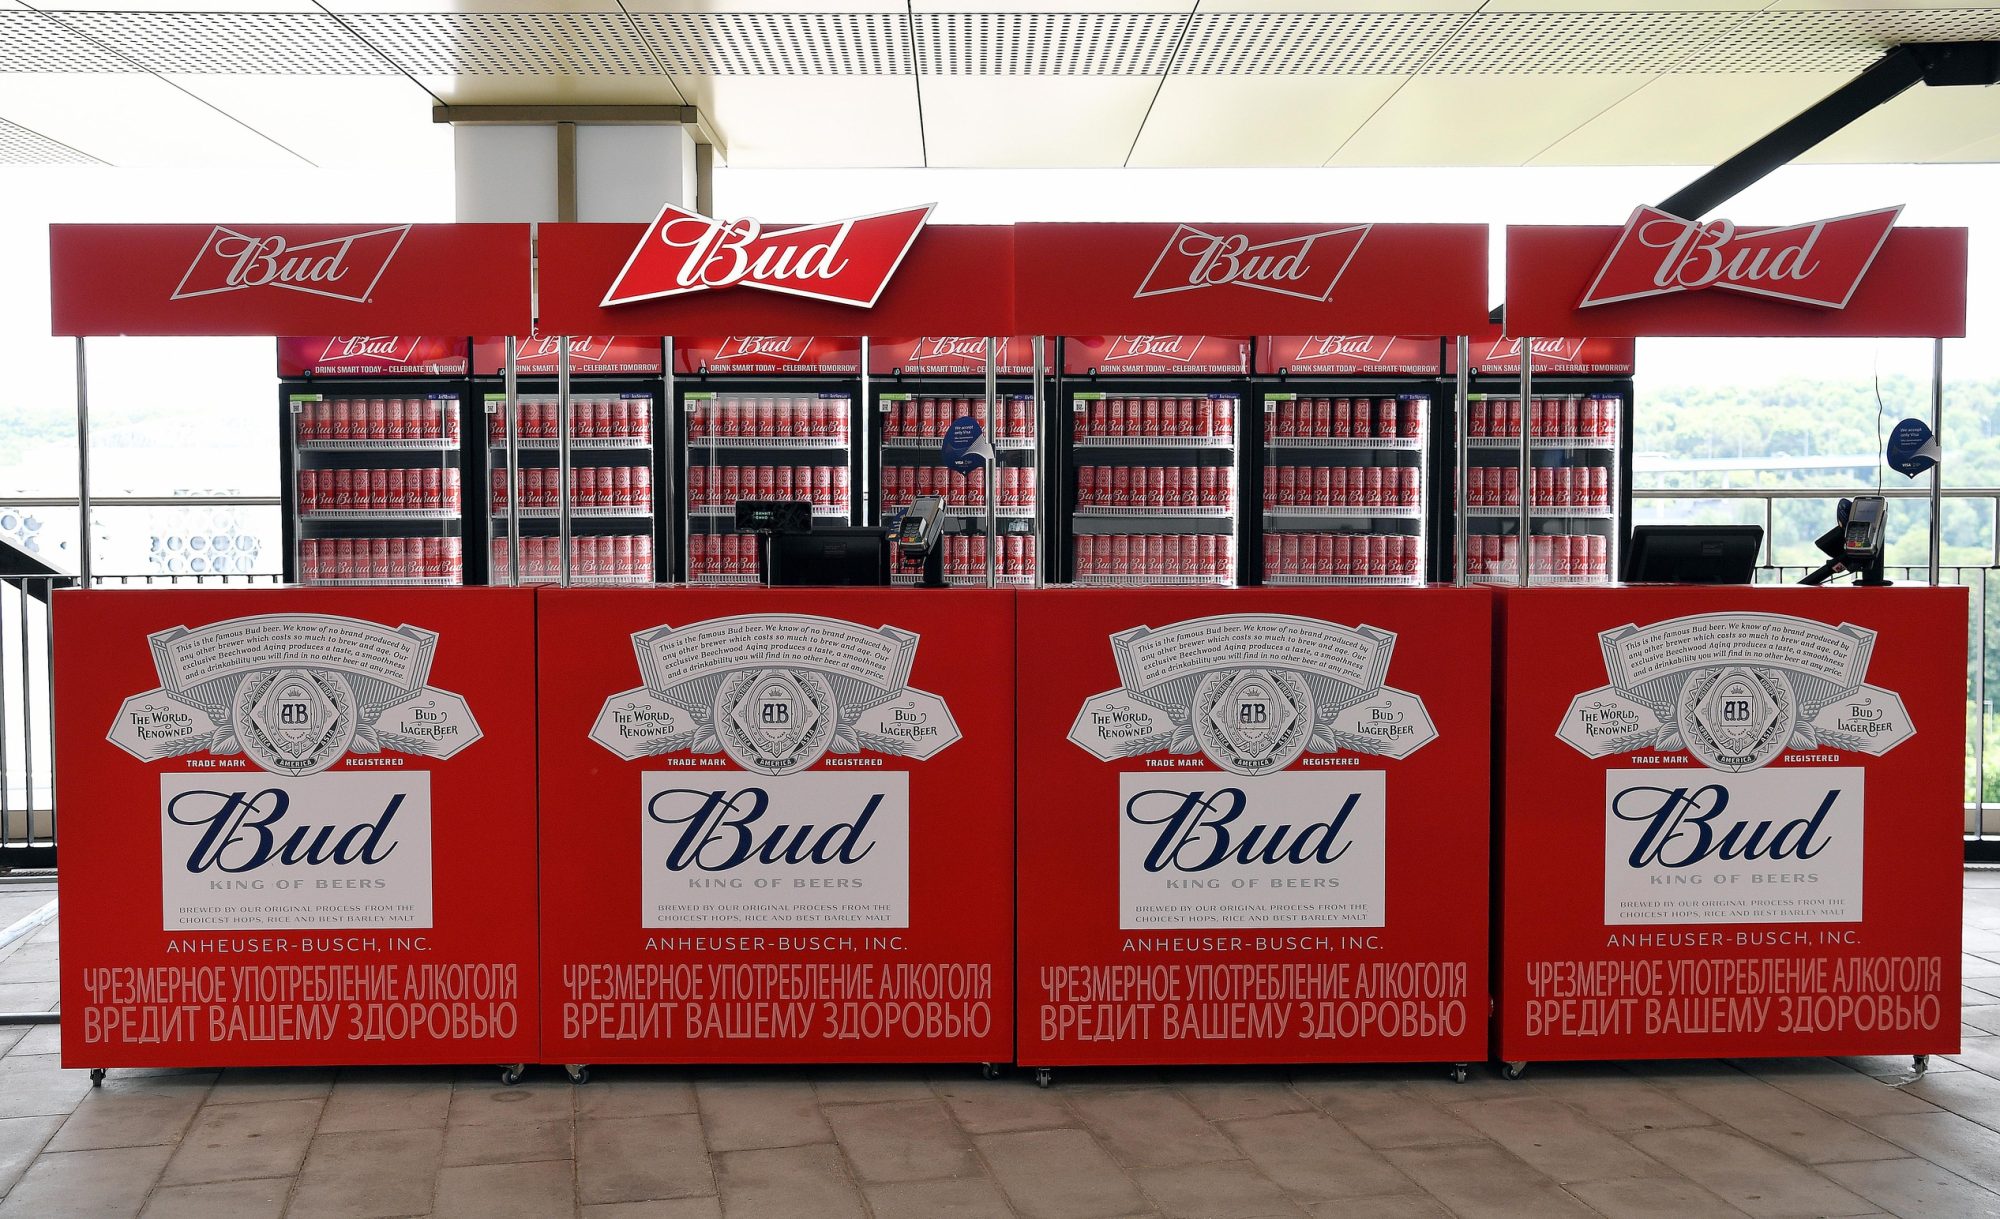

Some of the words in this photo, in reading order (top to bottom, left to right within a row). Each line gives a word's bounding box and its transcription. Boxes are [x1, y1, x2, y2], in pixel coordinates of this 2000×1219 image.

[661, 218, 856, 286] Bud
[1178, 234, 1316, 284] Bud
[1638, 219, 1826, 286] Bud
[215, 236, 354, 286] Bud
[338, 336, 398, 355] Bud
[734, 336, 792, 354] Bud
[928, 336, 987, 354] Bud
[1124, 336, 1183, 354] Bud
[1315, 336, 1373, 354] Bud
[710, 364, 730, 372] DRINK
[732, 364, 754, 372] SMART
[755, 364, 775, 372] TODAY
[782, 364, 818, 372] CELEBRATE
[818, 364, 856, 372] TOMORROW
[176, 643, 192, 653] This
[202, 636, 213, 645] the
[215, 631, 243, 643] famous
[245, 626, 260, 634] Bud
[318, 625, 328, 633] of
[340, 628, 363, 639] brand
[365, 634, 400, 648] produced
[401, 642, 410, 653] by
[130, 713, 150, 724] THE
[152, 712, 192, 726] WORLD
[282, 704, 308, 724] AB
[415, 709, 437, 720] BUD
[613, 712, 632, 723] THE
[634, 711, 674, 725] WORLD
[763, 703, 789, 724] AB
[895, 710, 917, 721] BUD
[1091, 713, 1110, 724] THE
[1112, 711, 1152, 726] WORLD
[1240, 703, 1267, 724] AB
[1372, 709, 1393, 720] BUD
[1579, 710, 1598, 721] THE
[1600, 709, 1639, 723] WORLD
[1724, 701, 1750, 721] AB
[1852, 706, 1873, 717] BUD
[138, 726, 192, 740] RENOWNED
[400, 722, 433, 737] LAGER
[434, 725, 458, 735] BEER
[620, 725, 674, 738] RENOWNED
[880, 722, 912, 738] LAGER
[913, 726, 937, 736] BEER
[1098, 726, 1152, 739] RENOWNED
[1357, 721, 1389, 737] LAGER
[1390, 725, 1414, 735] BEER
[1586, 723, 1639, 737] RENOWNED
[1837, 718, 1868, 734] LAGER
[1869, 722, 1892, 732] BEER
[321, 730, 335, 746] ASIA
[346, 758, 404, 766] REGISTERED
[1146, 759, 1174, 767] TRADE
[167, 788, 406, 873] Bud
[648, 787, 884, 872] Bud
[1126, 788, 1361, 872] Bud
[1611, 784, 1840, 868] Bud
[210, 880, 264, 890] KING
[275, 879, 304, 890] OF
[316, 879, 386, 889] BEERS
[689, 878, 743, 888] KING
[754, 878, 782, 888] OF
[794, 878, 864, 888] BEERS
[1167, 879, 1220, 889] KING
[1231, 879, 1259, 889] OF
[1271, 878, 1340, 888] BEERS
[1651, 874, 1703, 884] KING
[1713, 874, 1740, 884] OF
[1752, 873, 1819, 883] BEERS
[658, 914, 707, 922] CHOICEST
[711, 914, 742, 923] HOPS,
[167, 938, 382, 953] ANHEUSER-BUSCH,
[389, 937, 432, 951] INC.
[645, 936, 858, 951] ANHEUSER-BUSCH,
[865, 936, 908, 950] INC.
[1123, 936, 1334, 952] ANHEUSER-BUSCH,
[1341, 936, 1384, 950] INC.
[1607, 931, 1813, 947] ANHEUSER-BUSCH,
[1819, 930, 1861, 944] INC.
[84, 966, 226, 1004] ЧРЕЗМЕРНОЕ
[231, 965, 398, 1002] УПОТРЕБЛЕНИЕ
[403, 964, 517, 1000] АЛКОГОЛЯ
[563, 963, 704, 1000] ЧРЕЗМЕРНОЕ
[708, 963, 874, 1000] УПОТРЕБЛЕНИЕ
[879, 963, 991, 999] АЛКОГОЛЯ
[1041, 964, 1181, 1002] ЧРЕЗМЕРНОЕ
[1185, 963, 1350, 1000] УПОТРЕБЛЕНИЕ
[1355, 962, 1467, 998] АЛКОГОЛЯ
[1527, 960, 1663, 997] ЧРЕЗМЕРНОЕ
[1667, 958, 1827, 995] УПОТРЕБЛЕНИЕ
[1832, 957, 1941, 992] АЛКОГОЛЯ
[85, 1005, 201, 1043] ВРЕДИТ
[209, 1004, 340, 1042] ВАШЕМУ
[347, 1002, 517, 1040] ЗДОРОВЬЮ
[563, 1002, 678, 1039] ВРЕДИТ
[686, 1002, 815, 1039] ВАШЕМУ
[822, 1001, 991, 1039] ЗДОРОВЬЮ
[1041, 1003, 1155, 1041] ВРЕДИТ
[1163, 1002, 1292, 1040] ВАШЕМУ
[1299, 1000, 1466, 1039] ЗДОРОВЬЮ
[1526, 998, 1637, 1036] ВРЕДИТ
[1646, 997, 1771, 1034] ВАШЕМУ
[1777, 995, 1940, 1032] ЗДОРОВЬЮ
